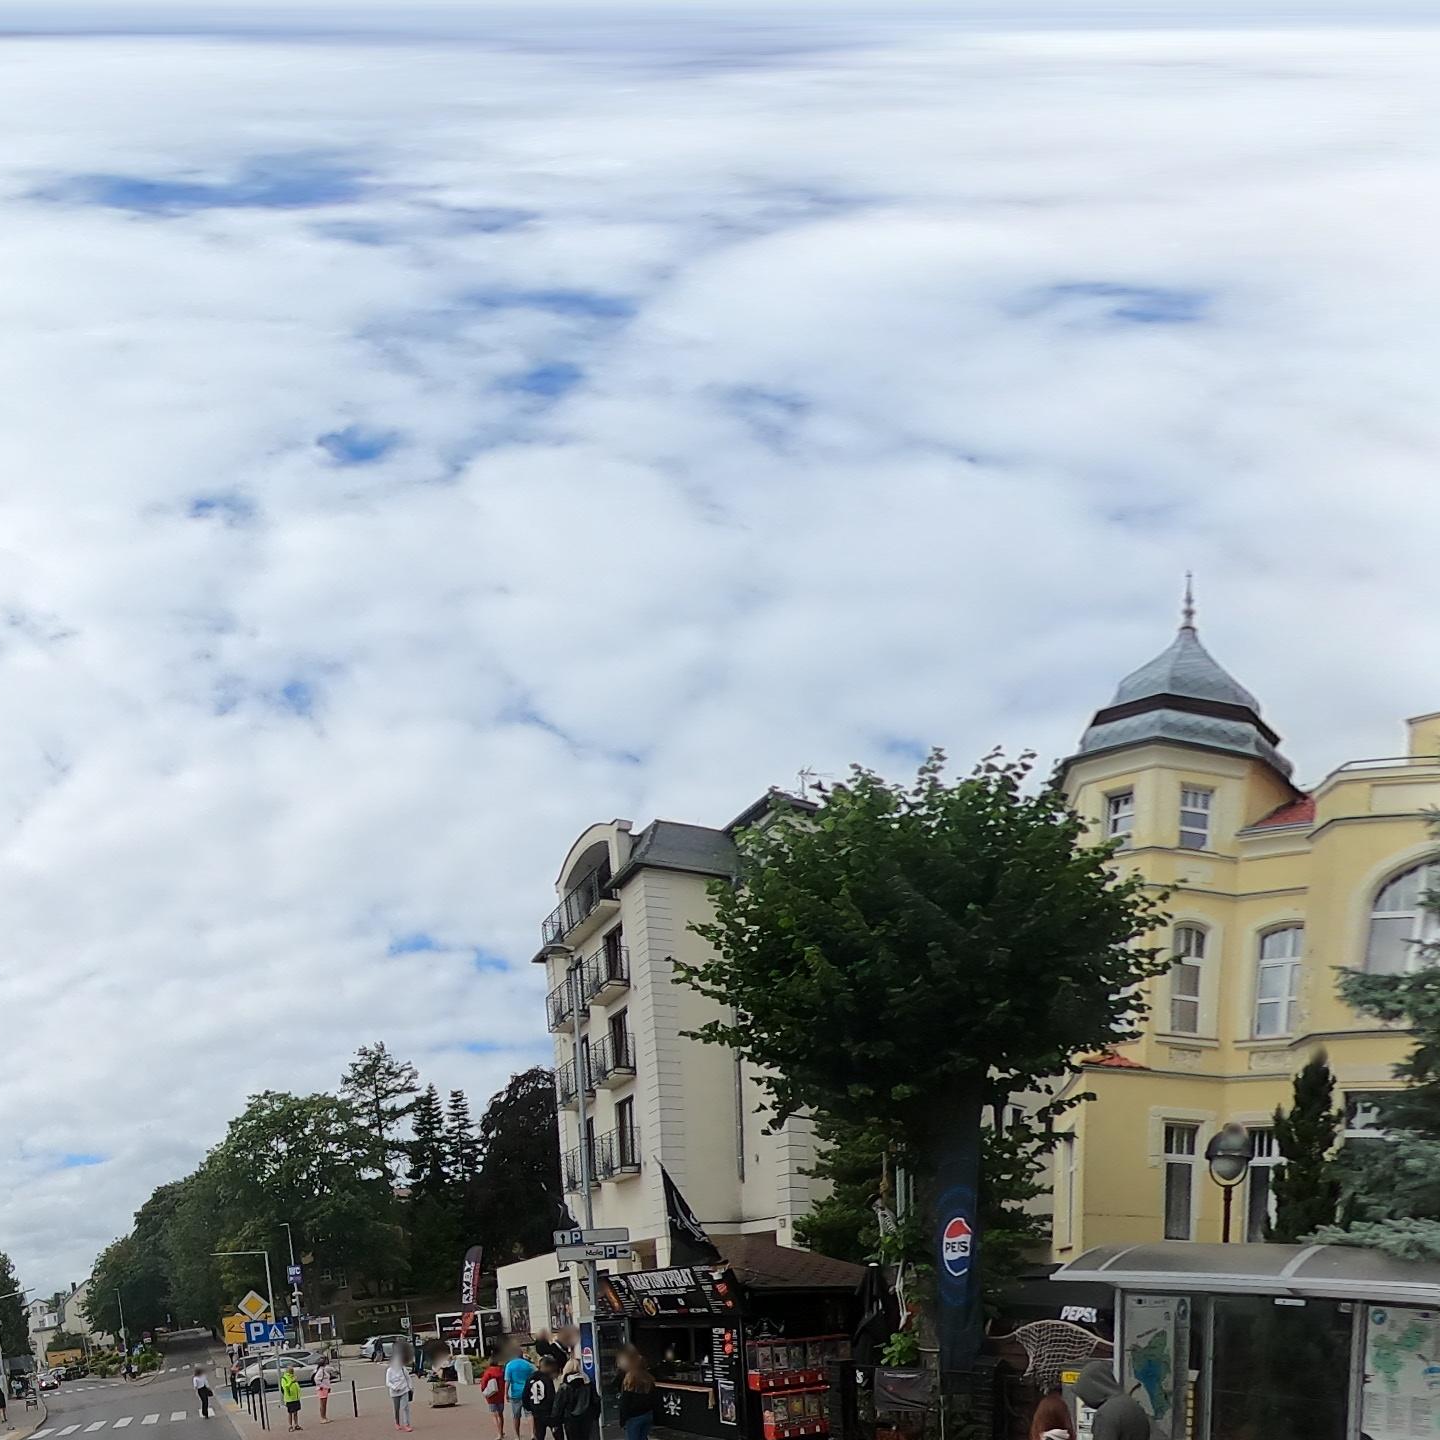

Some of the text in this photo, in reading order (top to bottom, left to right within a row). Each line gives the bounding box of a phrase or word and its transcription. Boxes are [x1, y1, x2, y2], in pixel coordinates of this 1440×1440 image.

[288, 1266, 302, 1276] WC
[462, 1260, 474, 1304] RYBY
[1060, 1305, 1097, 1323] PEPSI
[250, 1322, 265, 1341] P
